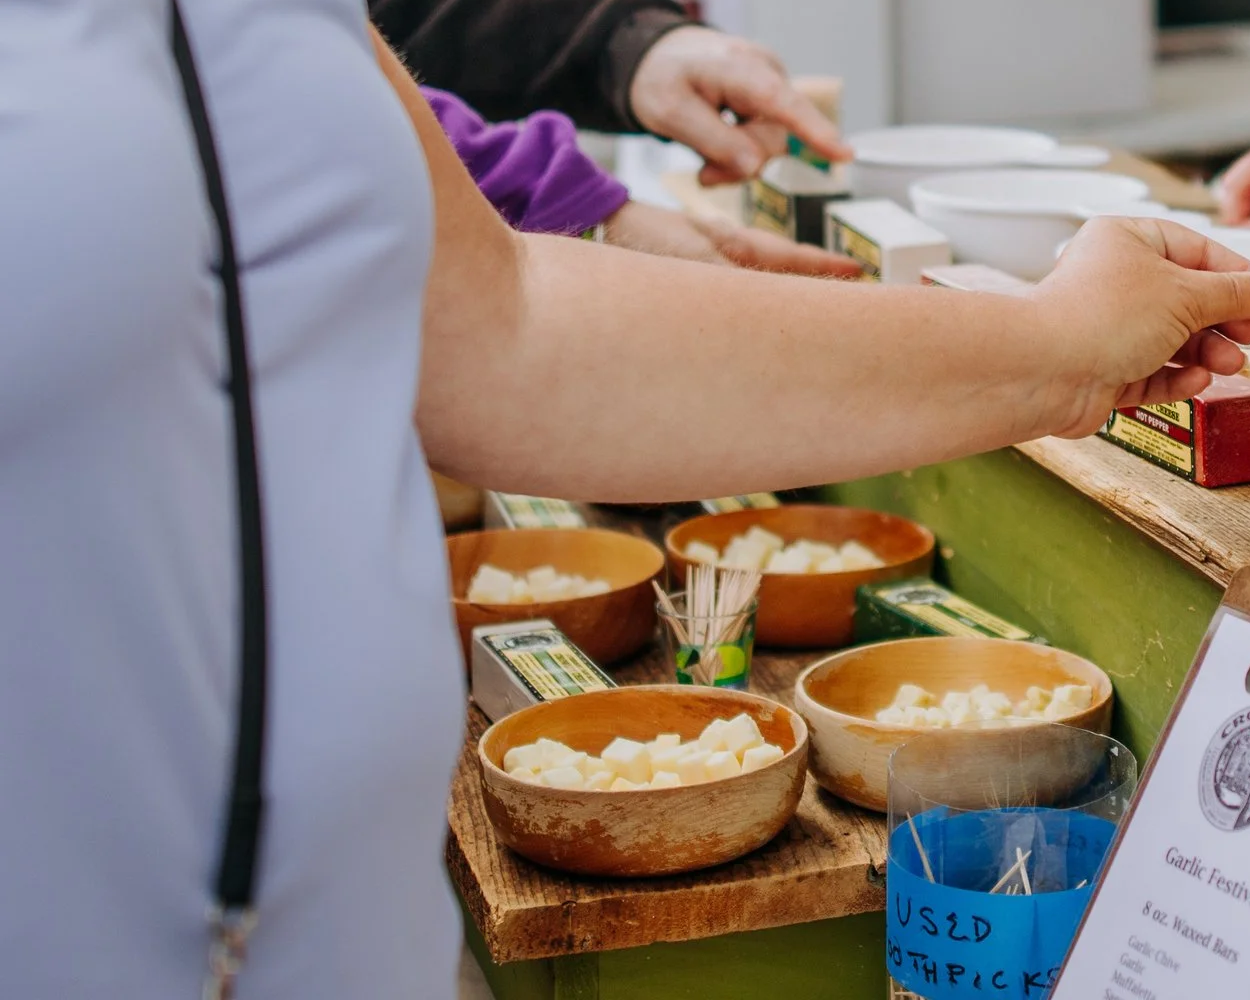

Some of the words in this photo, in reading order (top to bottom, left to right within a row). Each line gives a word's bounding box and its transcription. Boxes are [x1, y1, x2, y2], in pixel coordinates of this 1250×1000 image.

[1135, 409, 1149, 423] HOT
[1148, 415, 1170, 434] PEPPER
[1155, 403, 1180, 423] CHEESE
[1164, 846, 1205, 882] Garlic
[896, 893, 992, 943] USED
[1142, 900, 1152, 916] 8
[1171, 915, 1214, 949] Waxed
[1212, 938, 1240, 964] Bars
